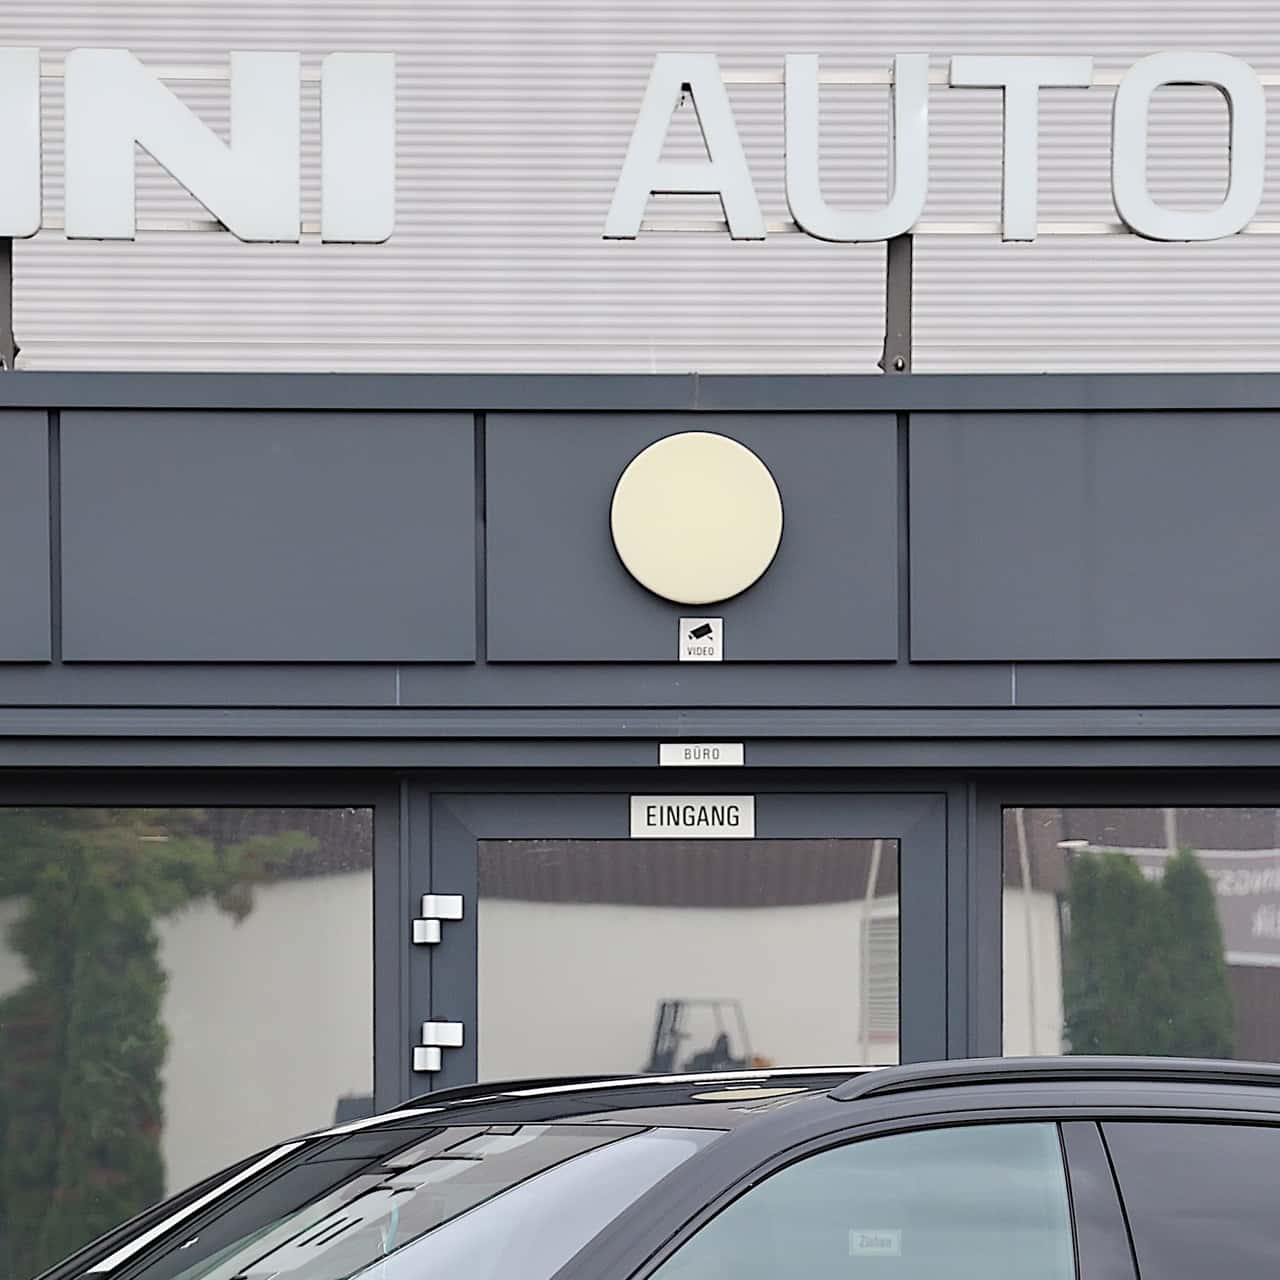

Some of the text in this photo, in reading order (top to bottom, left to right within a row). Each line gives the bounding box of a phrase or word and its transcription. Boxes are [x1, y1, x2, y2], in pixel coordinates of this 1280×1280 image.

[603, 50, 1266, 243] AUTO
[687, 647, 714, 656] VIDEO
[684, 745, 720, 760] BÜRO
[646, 805, 740, 827] EINGANG
